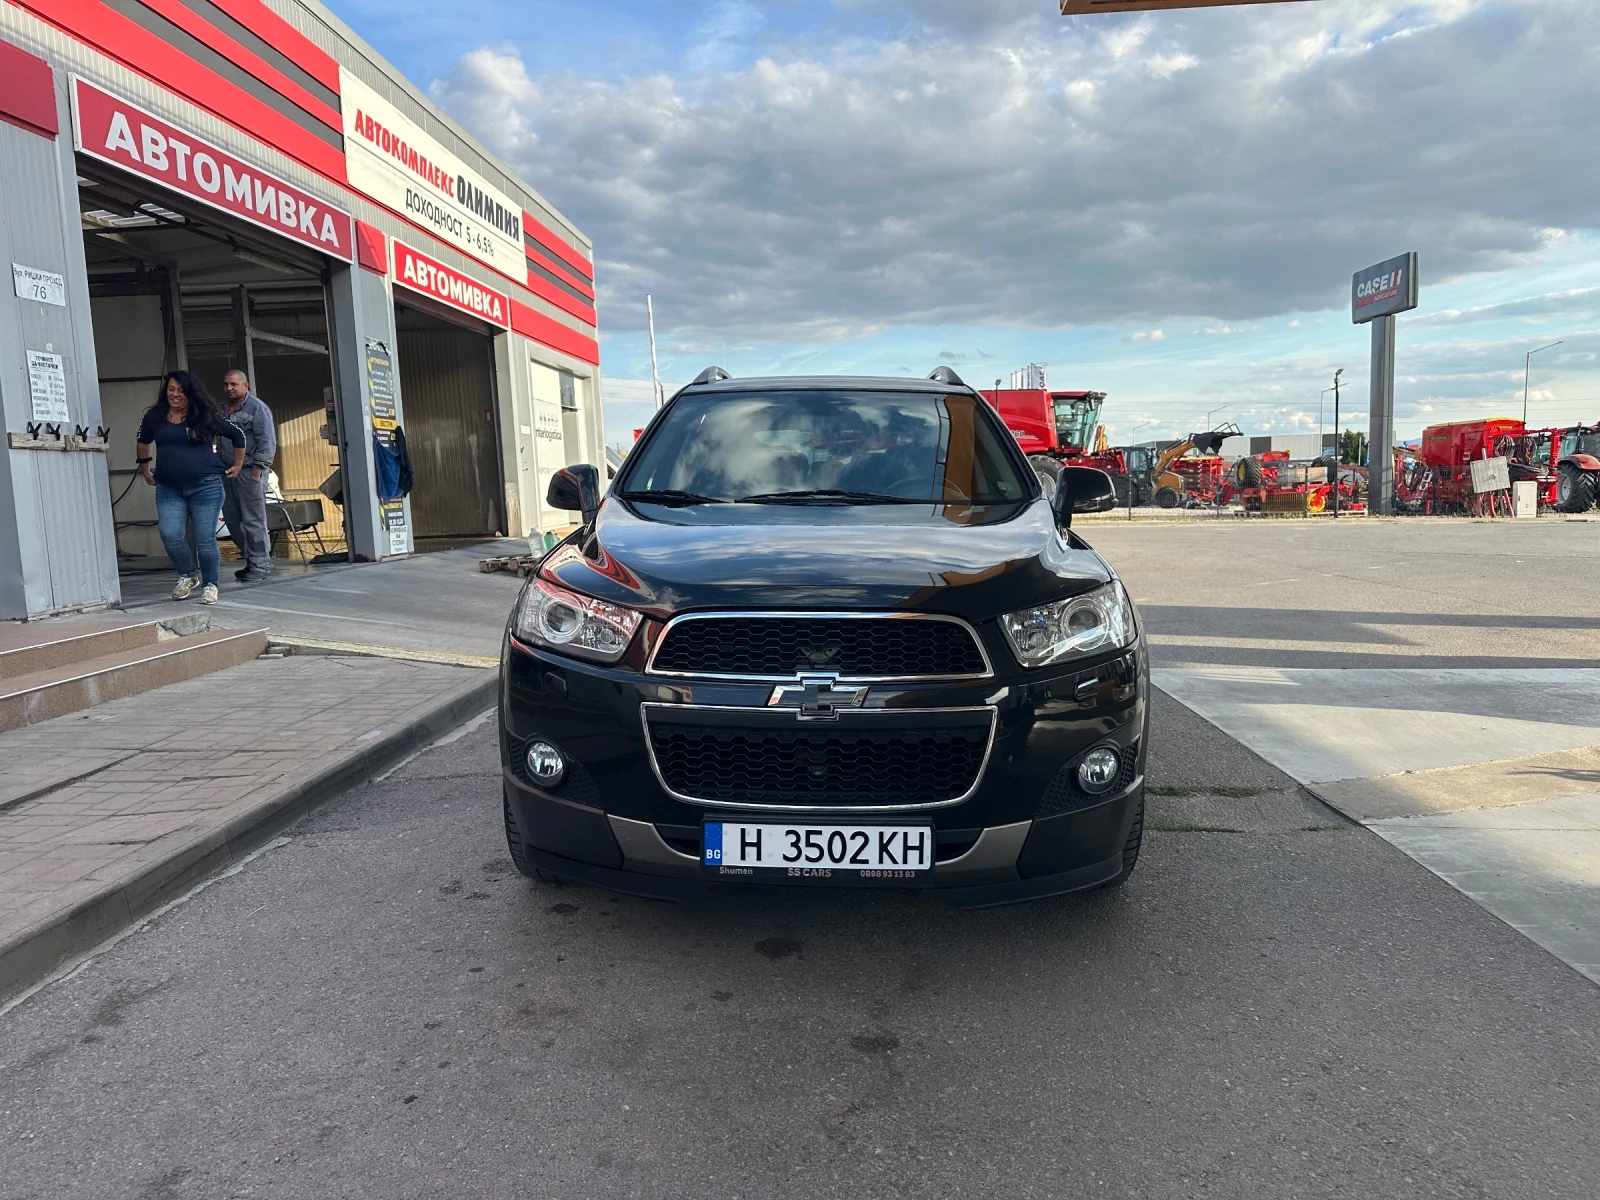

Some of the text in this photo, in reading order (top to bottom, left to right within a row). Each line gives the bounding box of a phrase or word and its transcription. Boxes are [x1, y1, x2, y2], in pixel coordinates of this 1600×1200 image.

[105, 110, 340, 248] АВТОМИВКА
[354, 108, 520, 242] АВТОКОМПЛЕКС ОЛИМПИЯ
[405, 187, 463, 238] ДОХОДНОСТ
[33, 284, 47, 300] 76
[403, 254, 503, 321] АВТОМИВКА
[1357, 273, 1390, 298] CASE
[1373, 288, 1398, 301] AGRICULTURE
[535, 427, 563, 442] nterlogistica
[740, 827, 925, 865] H 3502 KH
[706, 849, 721, 860] BG
[719, 866, 753, 875] Shumen
[787, 867, 832, 877] SS CARS
[860, 869, 916, 878] 0898 93 13 83
